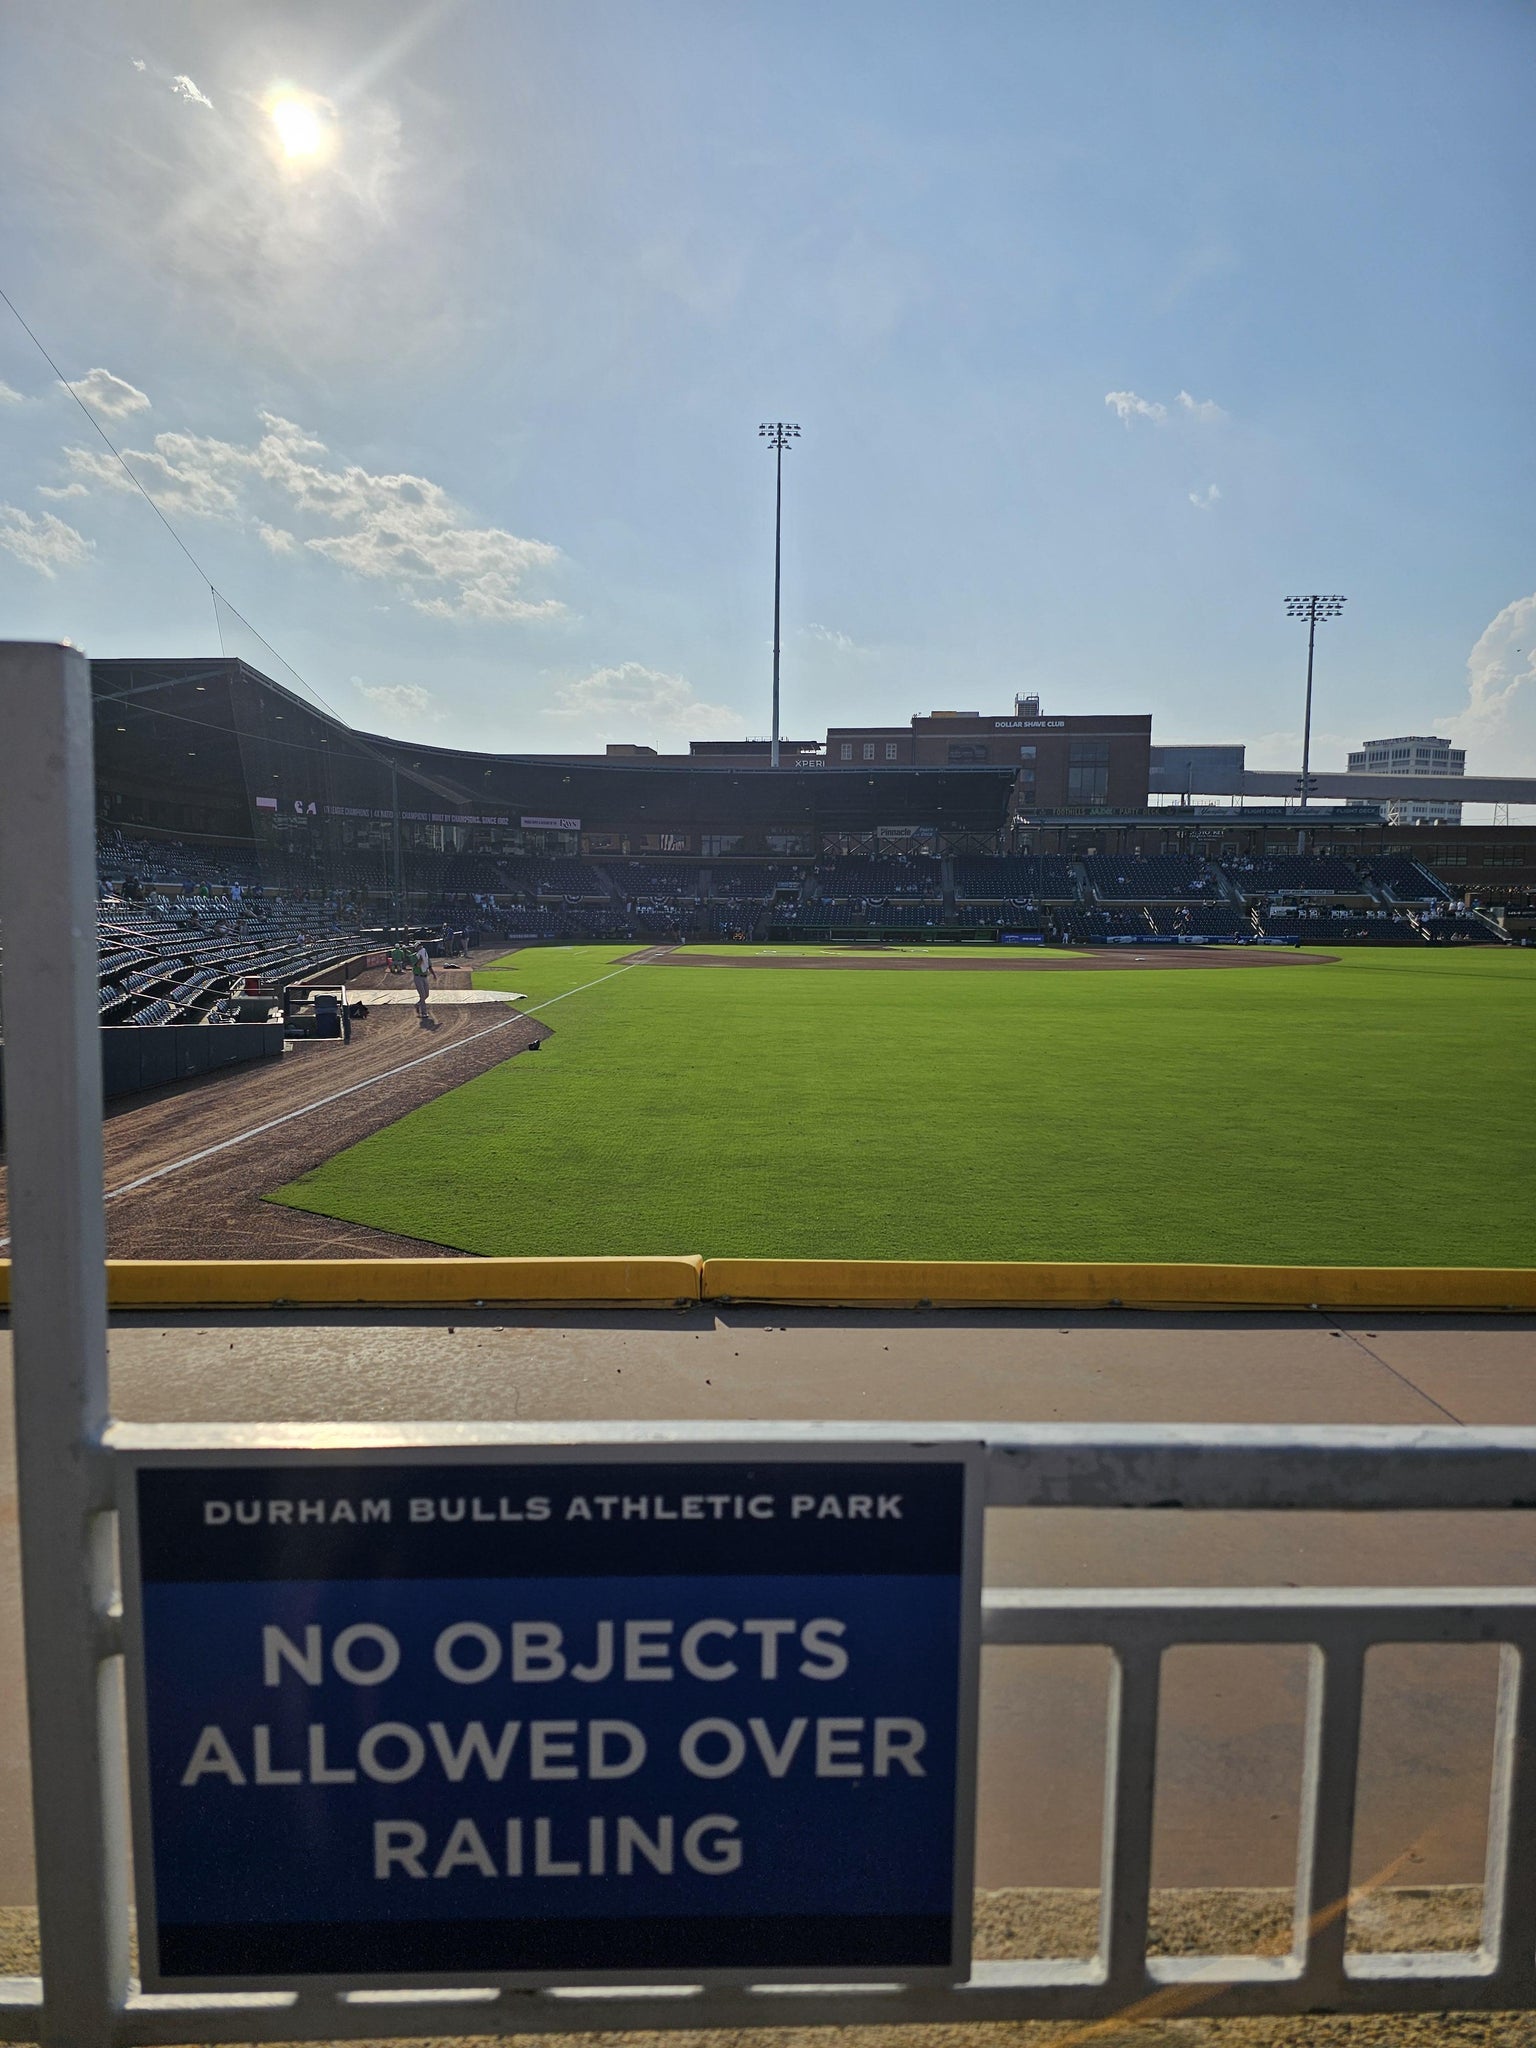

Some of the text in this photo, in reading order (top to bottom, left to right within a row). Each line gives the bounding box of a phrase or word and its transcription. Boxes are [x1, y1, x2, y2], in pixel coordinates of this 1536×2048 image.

[880, 828, 912, 836] Pinnacle
[205, 1494, 903, 1526] DURHAM BULLS ATHLETIC PARK
[264, 1619, 848, 1687] NO OBJECTS
[181, 1718, 926, 1786] ALLOWED OVER
[374, 1815, 744, 1879] RAILING
